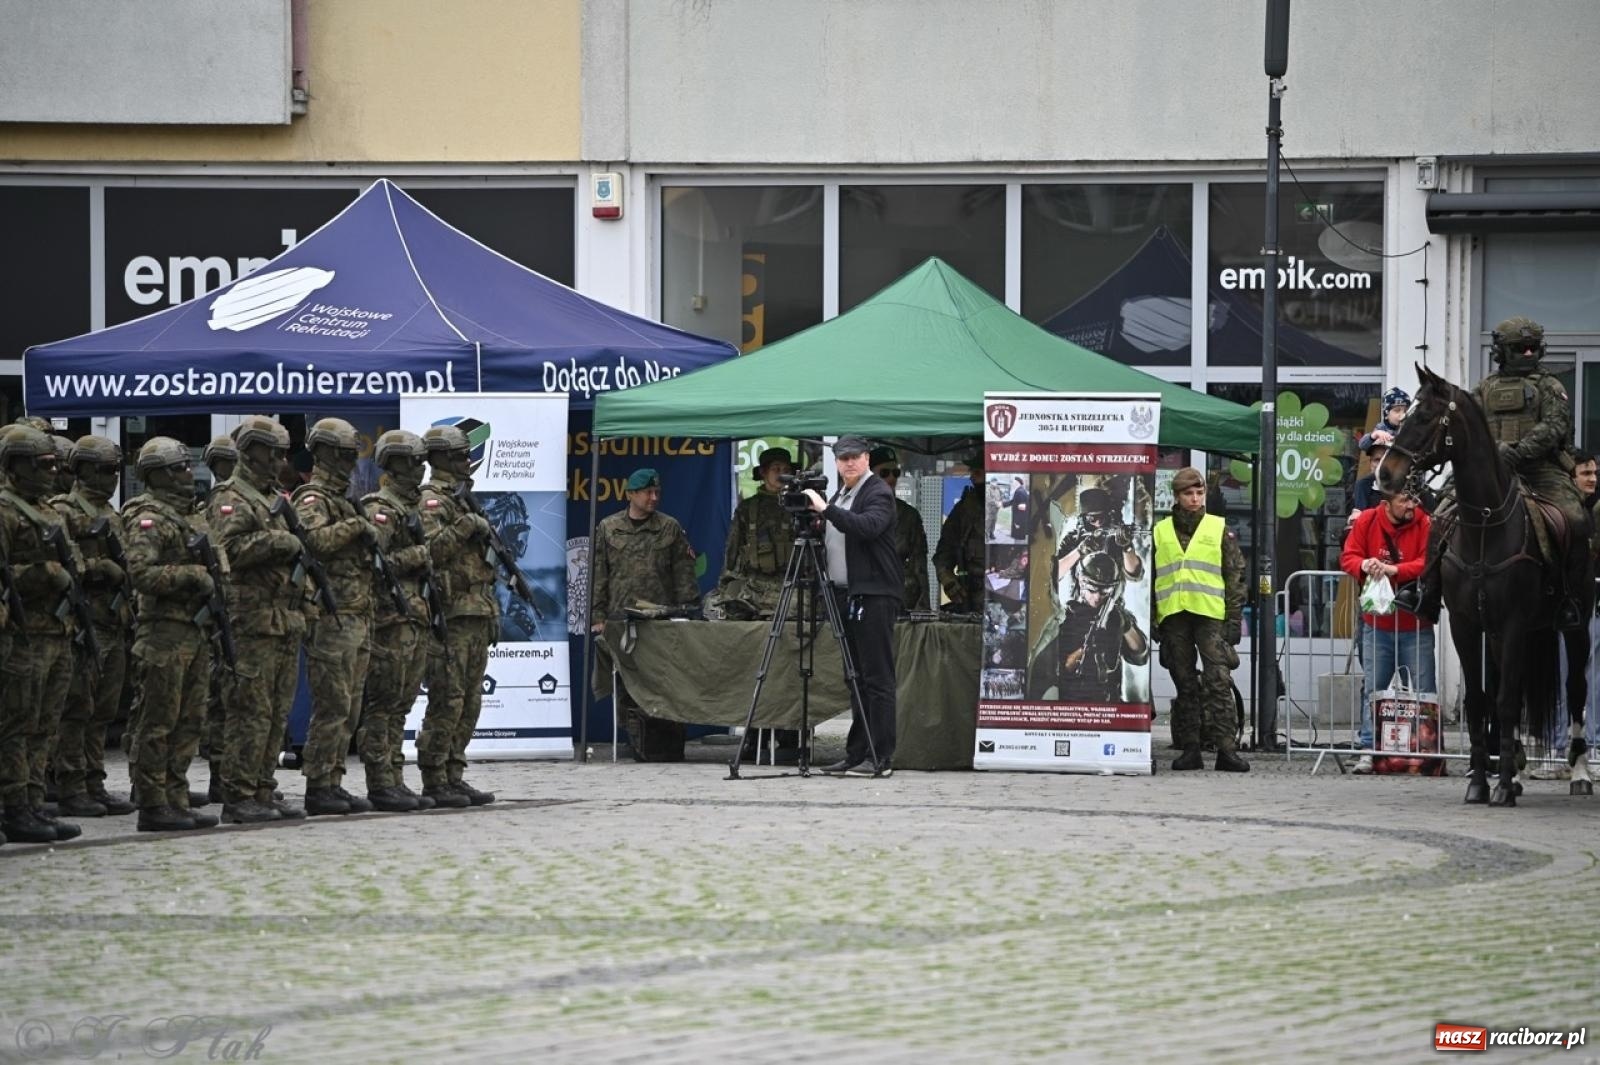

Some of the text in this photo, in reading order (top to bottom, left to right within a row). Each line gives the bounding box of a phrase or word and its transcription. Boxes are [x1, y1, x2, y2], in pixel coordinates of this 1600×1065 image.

[311, 303, 393, 320] Wojskowe
[299, 313, 368, 329] Centrum
[285, 323, 371, 340] Rekrutacji
[44, 360, 456, 398] www.zostanzolnierzem.pl
[543, 356, 610, 399] Dołącz
[615, 355, 641, 390] do
[1018, 413, 1125, 422] JEDNOSTKA STRZELECKA
[1287, 431, 1302, 441] dla
[1304, 431, 1335, 442] dzieci
[498, 440, 541, 450] Wojskowe
[495, 449, 531, 458] Centrum
[990, 452, 1150, 464] WYJDŹ Z DOMU! ZOSTAŃ STRZELCEM!
[493, 459, 536, 470] Rekrutacji
[501, 470, 536, 480] Rybniku
